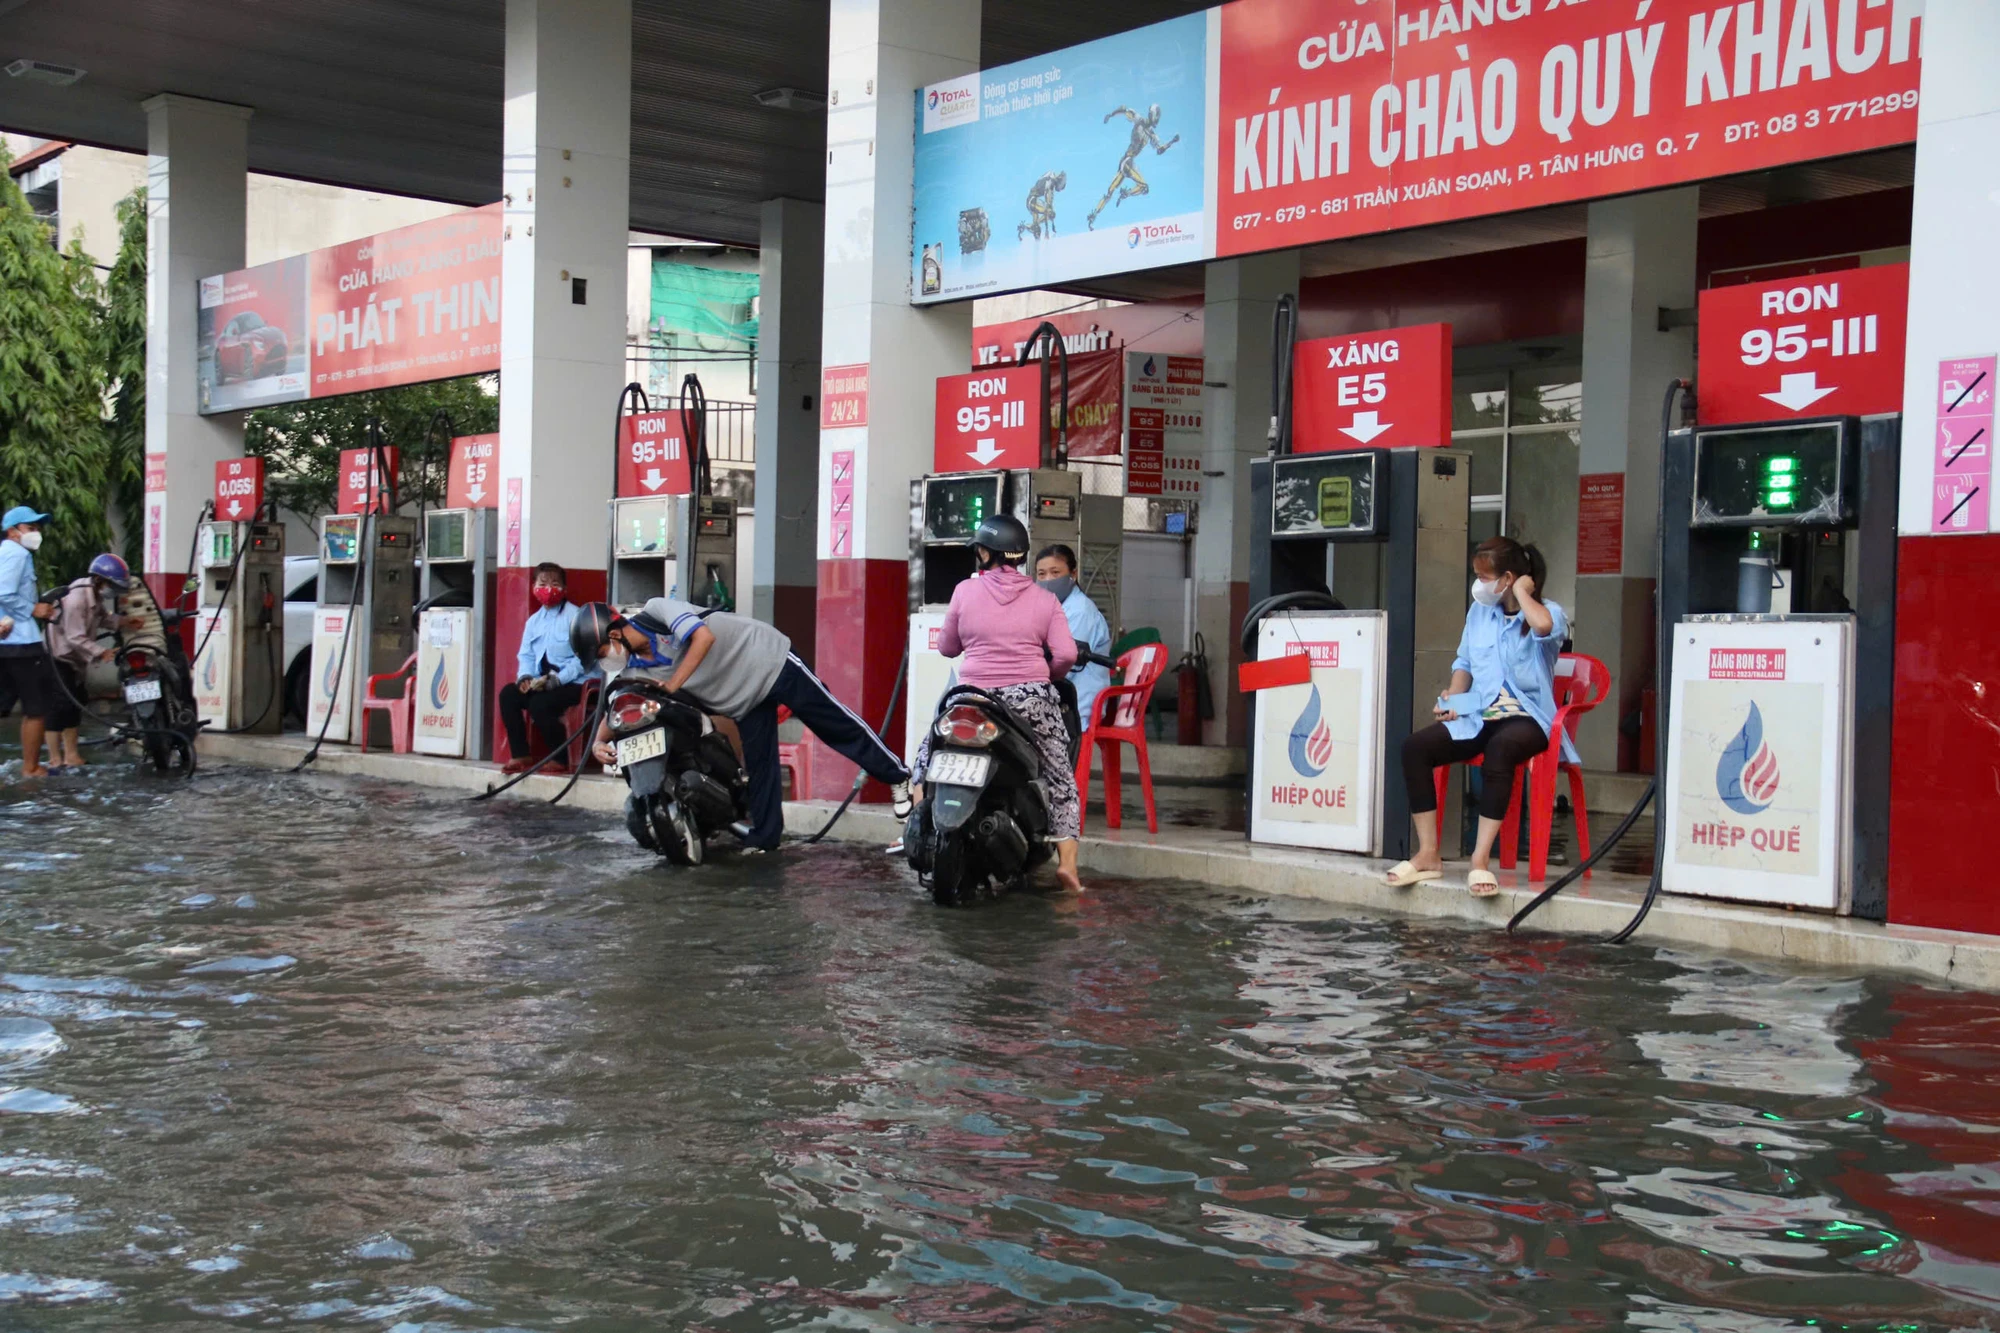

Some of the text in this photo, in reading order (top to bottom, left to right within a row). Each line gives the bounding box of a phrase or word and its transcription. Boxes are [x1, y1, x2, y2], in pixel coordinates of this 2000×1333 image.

[1298, 0, 1531, 70] CỬA HÀNG
[984, 83, 1006, 99] Động
[1021, 73, 1042, 89] sung
[1044, 65, 1061, 83] sức
[940, 88, 971, 103] TOTAL
[1053, 85, 1073, 104] gian
[1233, 87, 1351, 194] KÍNH
[1369, 44, 1518, 168] CHÀO
[1539, 0, 1667, 143] QUÝ
[1233, 211, 1262, 230] 677
[1275, 205, 1305, 223] 679
[1321, 197, 1349, 216] 681
[1354, 187, 1398, 210] TRẦN
[1403, 178, 1450, 202] XUÂN
[1456, 169, 1512, 192] SOẠN,
[1518, 163, 1534, 181] P.
[1540, 153, 1578, 177] TÂN
[1584, 142, 1644, 169] HƯNG
[1656, 136, 1678, 156] Q.
[1686, 133, 1699, 151] 7
[1724, 120, 1759, 143] ĐT:
[1766, 115, 1798, 136] 08
[1804, 110, 1819, 128] 3
[1827, 88, 1919, 124] 771299
[1143, 224, 1182, 238] TOTAL
[339, 268, 369, 293] CỬA
[1761, 283, 1838, 317] RON
[316, 292, 403, 357] PHÁT
[1740, 314, 1877, 366] 95-III
[1327, 340, 1399, 368] XĂNG
[968, 377, 1007, 398] RON
[1337, 372, 1386, 406] E5
[831, 400, 859, 422] 24/24
[957, 400, 1025, 433] 95-III
[1139, 417, 1154, 425] 95
[638, 418, 666, 434] RON
[463, 444, 493, 458] XĂNG
[632, 438, 680, 463] 95-III
[229, 463, 241, 475] DO
[466, 463, 487, 483] E5
[1711, 650, 1734, 669] XĂNG
[1736, 653, 1754, 669] RON
[1756, 654, 1767, 669] 95
[1774, 654, 1784, 670] III
[624, 732, 656, 751] 59-T1
[940, 753, 981, 769] 93-T1
[936, 766, 976, 783] 7744
[1271, 782, 1346, 808] HIỆP QUẾ
[1692, 820, 1800, 852] HIỆP QUẾ
